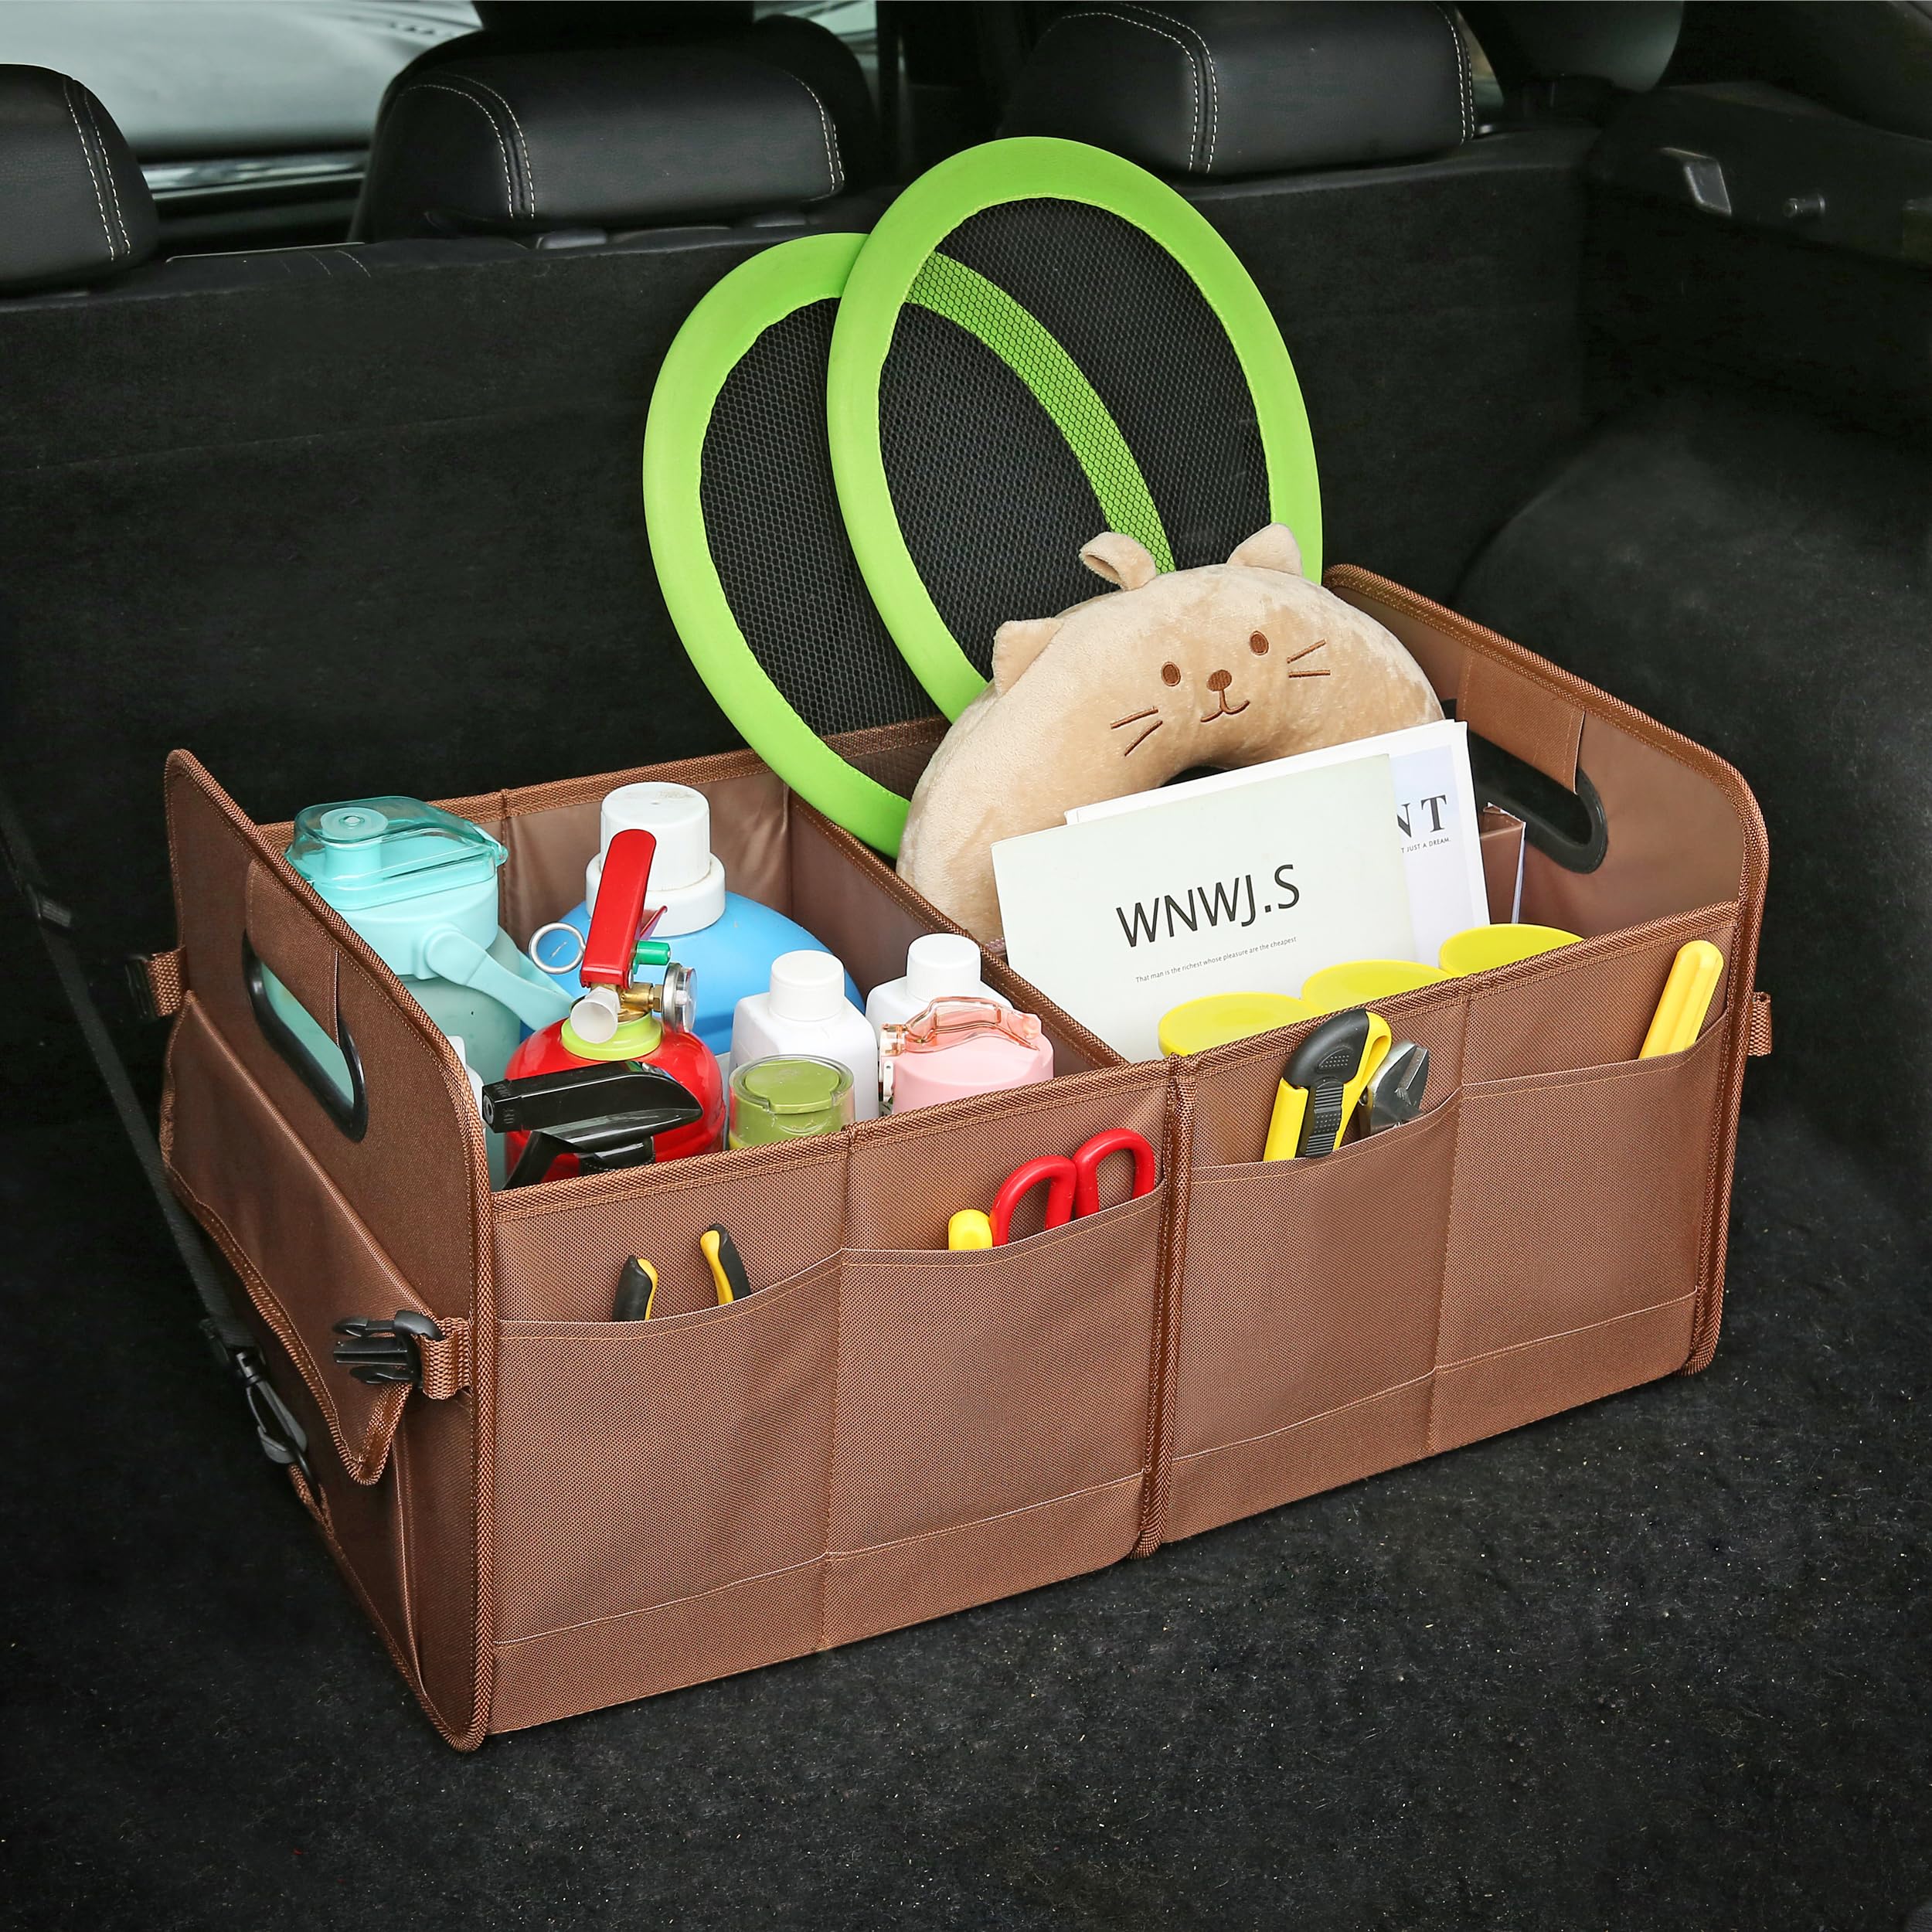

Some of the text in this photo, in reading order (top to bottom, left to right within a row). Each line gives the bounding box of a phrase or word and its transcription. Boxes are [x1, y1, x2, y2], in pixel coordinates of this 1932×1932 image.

[1406, 843, 1420, 853] JUST
[1115, 864, 1300, 947] WNWJ.S
[1135, 975, 1150, 983] That
[1182, 961, 1202, 971] richest
[1202, 956, 1222, 965] whose
[1223, 949, 1248, 961] pleasure
[1259, 943, 1269, 951] the
[1270, 936, 1297, 948] cheapest
